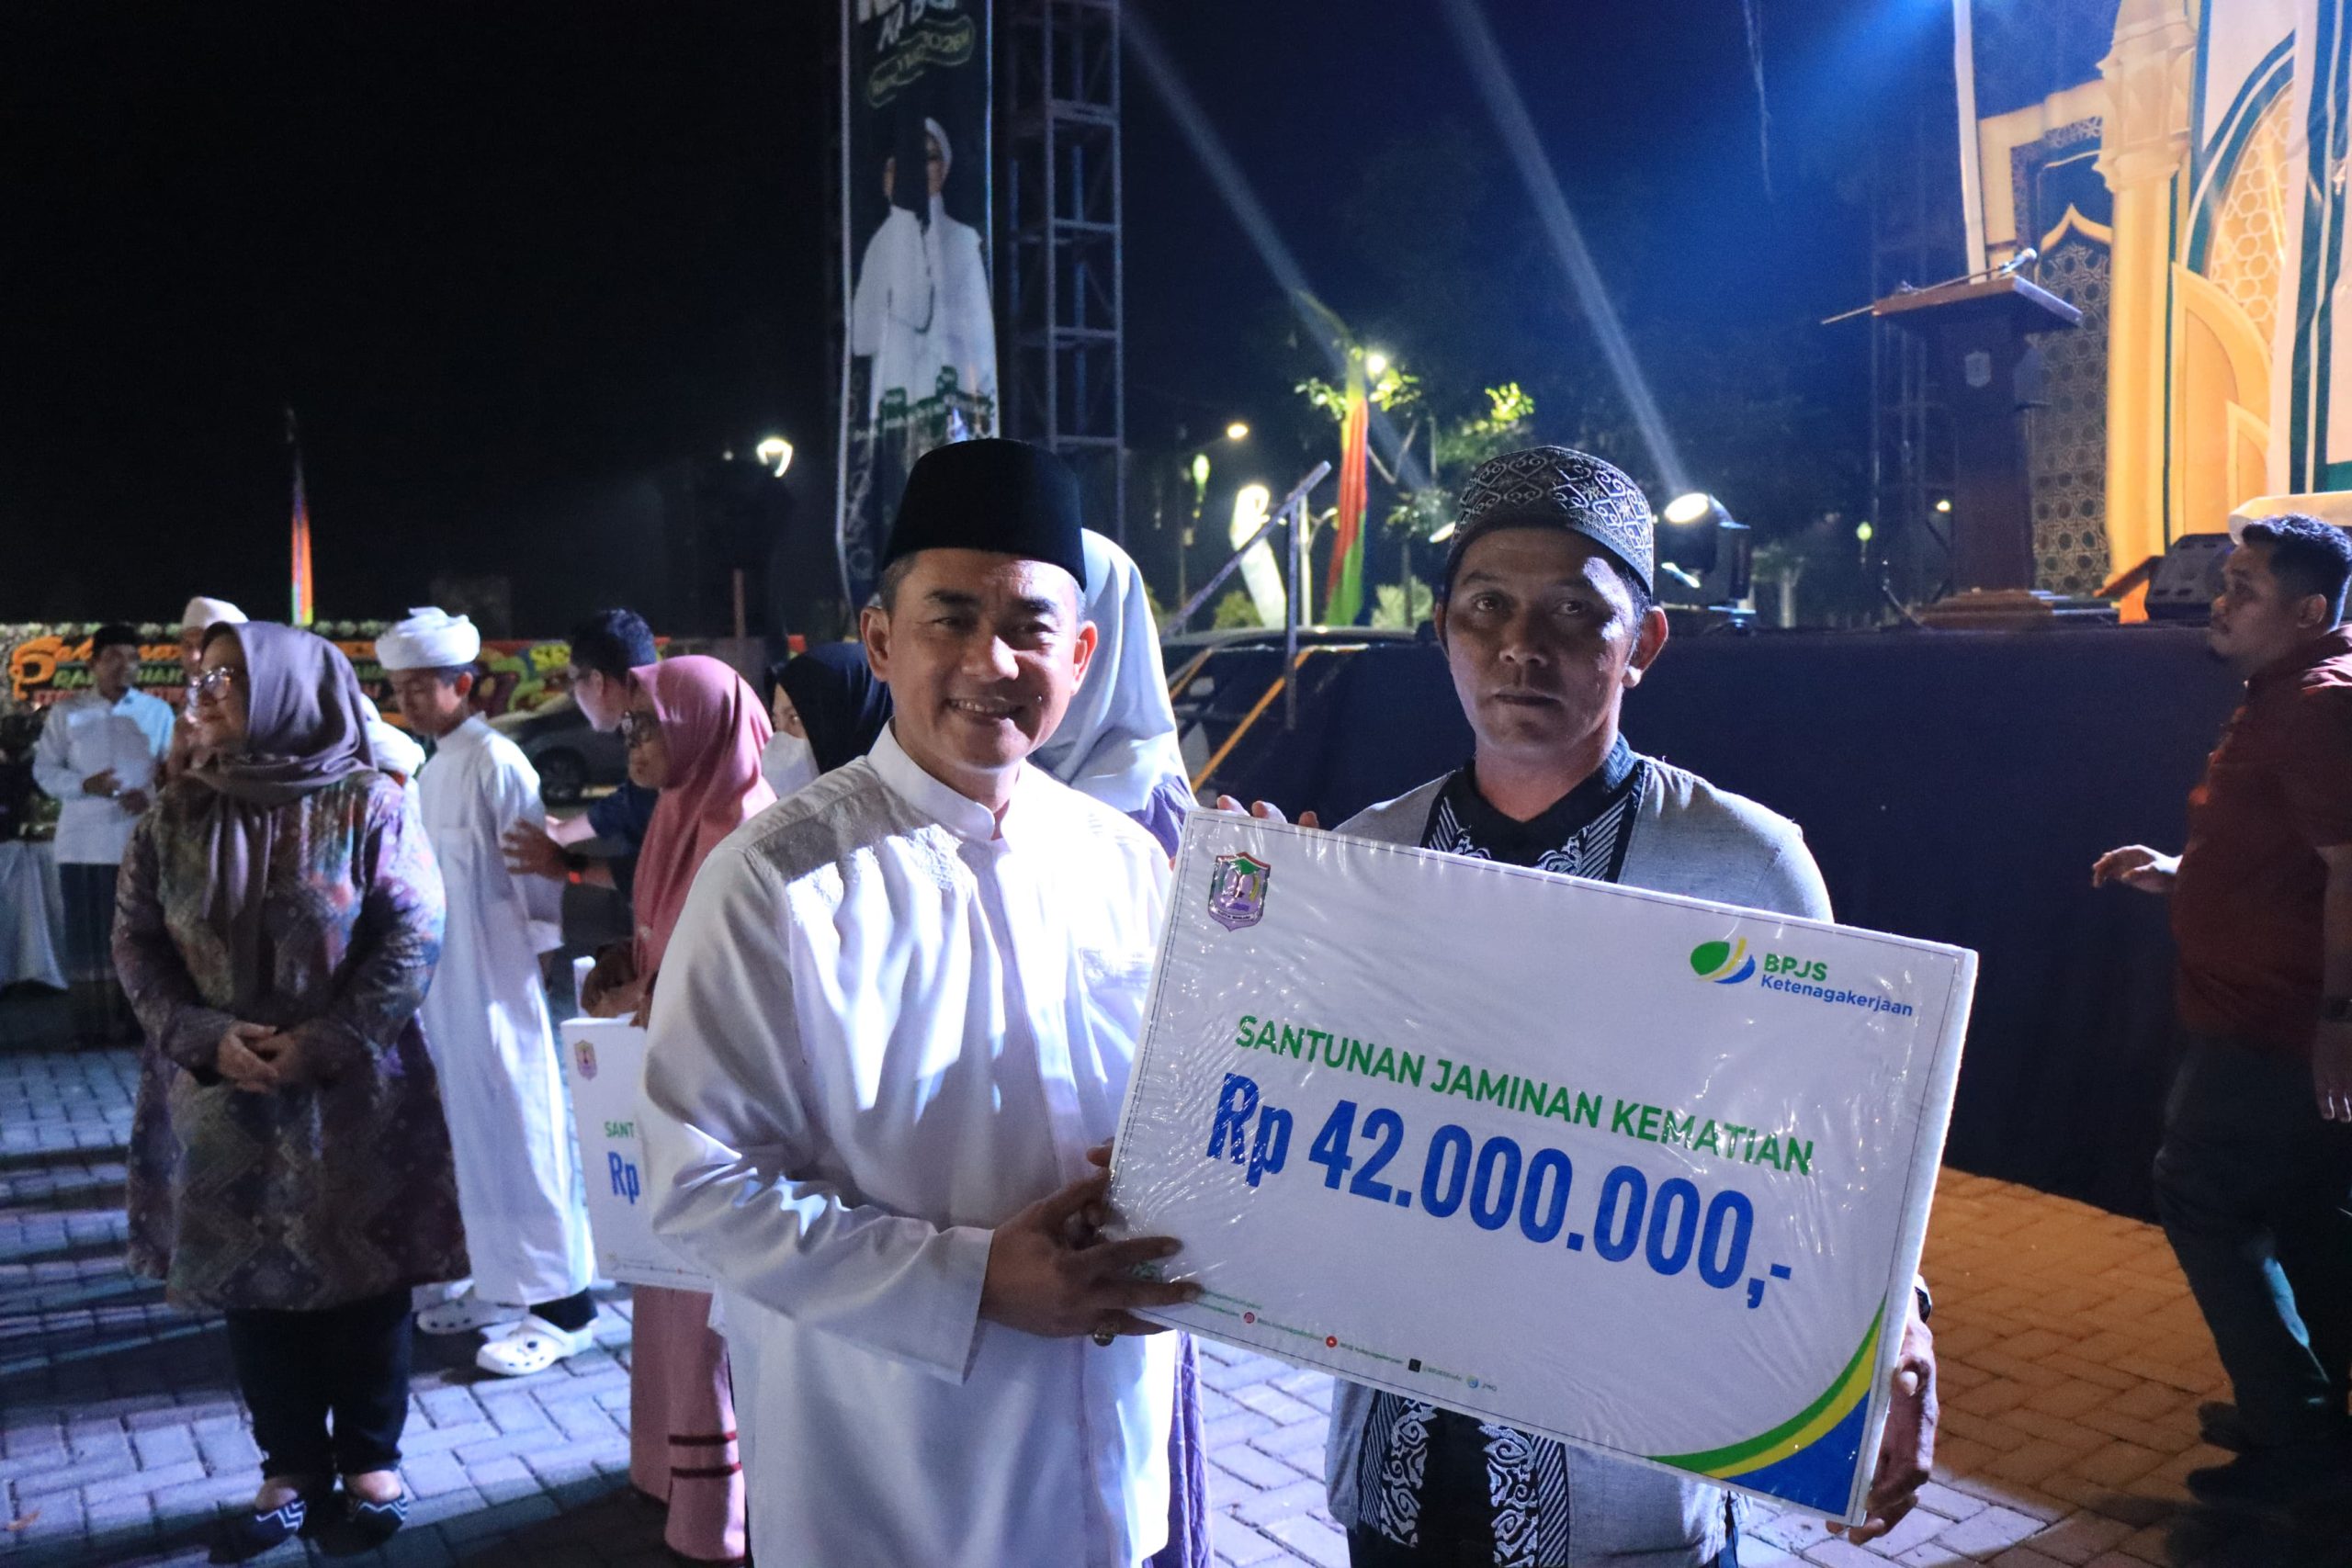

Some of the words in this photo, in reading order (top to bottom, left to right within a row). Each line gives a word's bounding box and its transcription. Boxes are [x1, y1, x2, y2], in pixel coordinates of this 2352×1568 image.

[1763, 953, 1828, 982] BPJS
[1760, 974, 1914, 1017] Ketenagakerjaan
[1235, 1015, 1426, 1087] SANTUNAN
[1430, 1059, 1601, 1128] JAMINAN
[1611, 1100, 1814, 1176] KEMATIAN
[604, 1121, 635, 1138] SANT
[607, 1150, 640, 1204] Rp
[1206, 1072, 1294, 1188] Rp
[1308, 1100, 1792, 1309] 42.000.000,-
